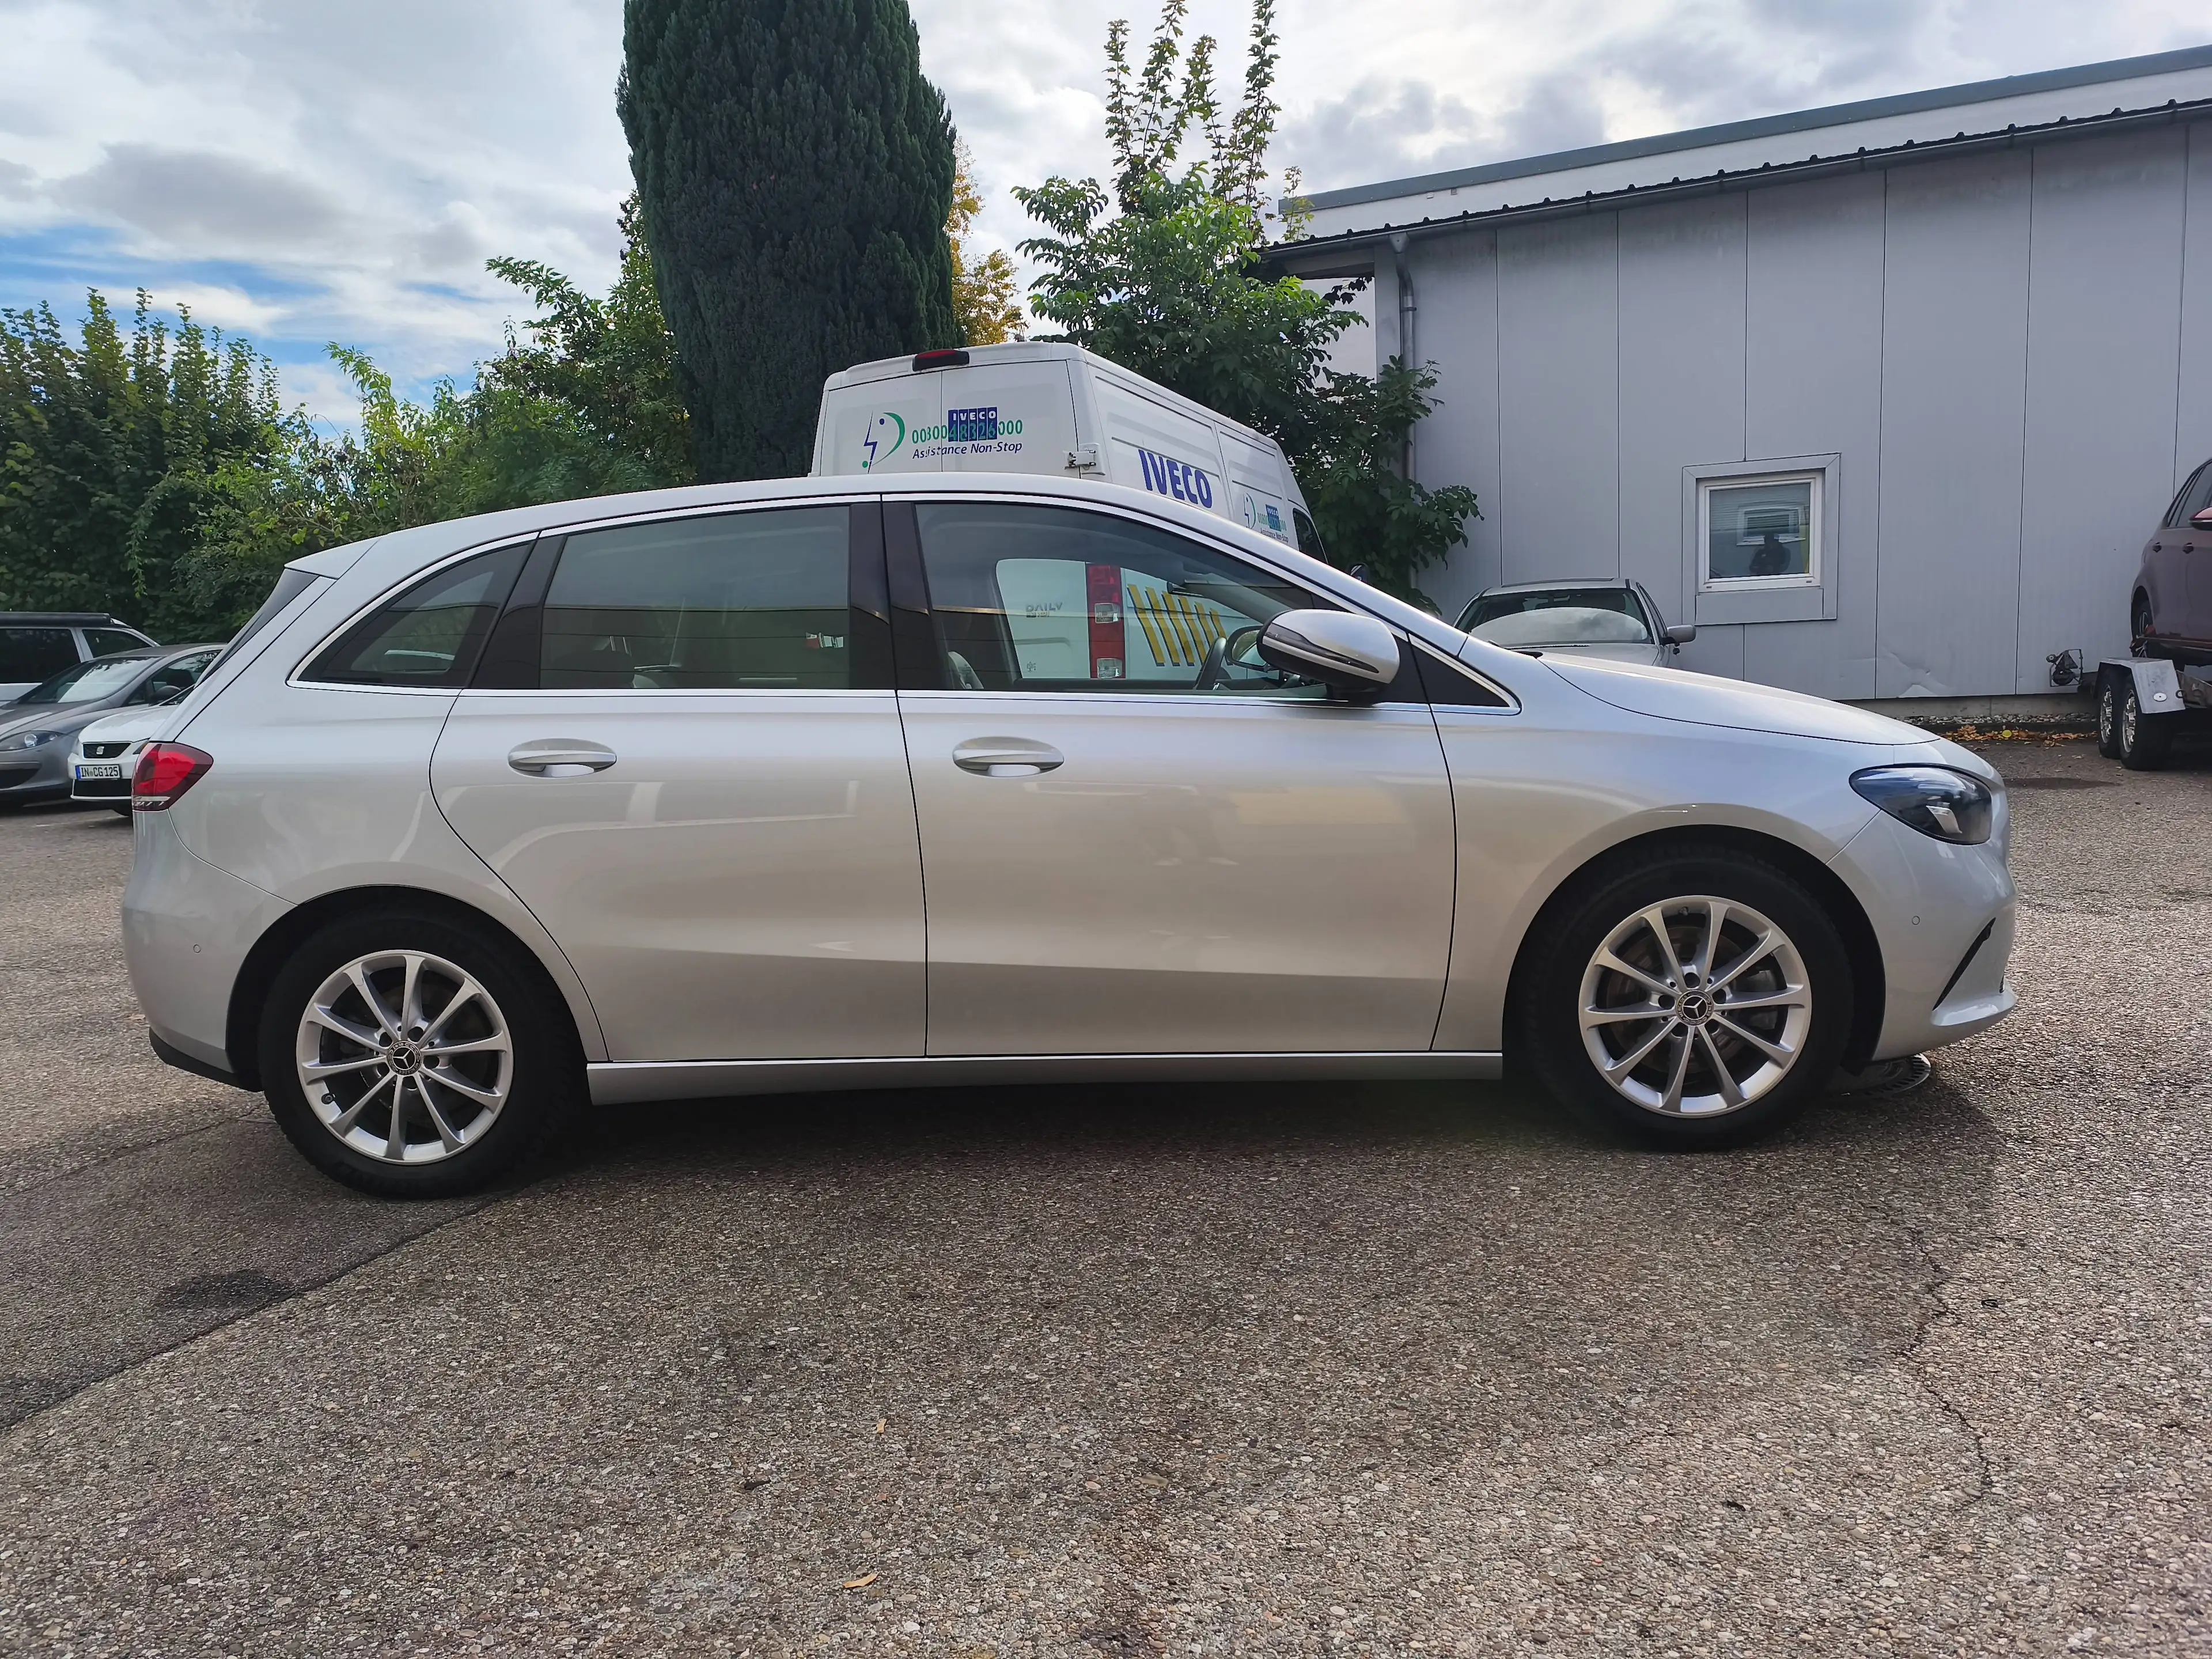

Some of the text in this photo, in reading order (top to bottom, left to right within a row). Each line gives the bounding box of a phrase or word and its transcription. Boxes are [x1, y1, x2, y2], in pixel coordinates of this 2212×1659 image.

[953, 411, 996, 421] IVECO
[912, 441, 1022, 459] Assistance Non-Stop
[1138, 449, 1212, 508] IVECO
[1026, 602, 1063, 612] DAILY
[81, 766, 119, 777] IN CG 125
